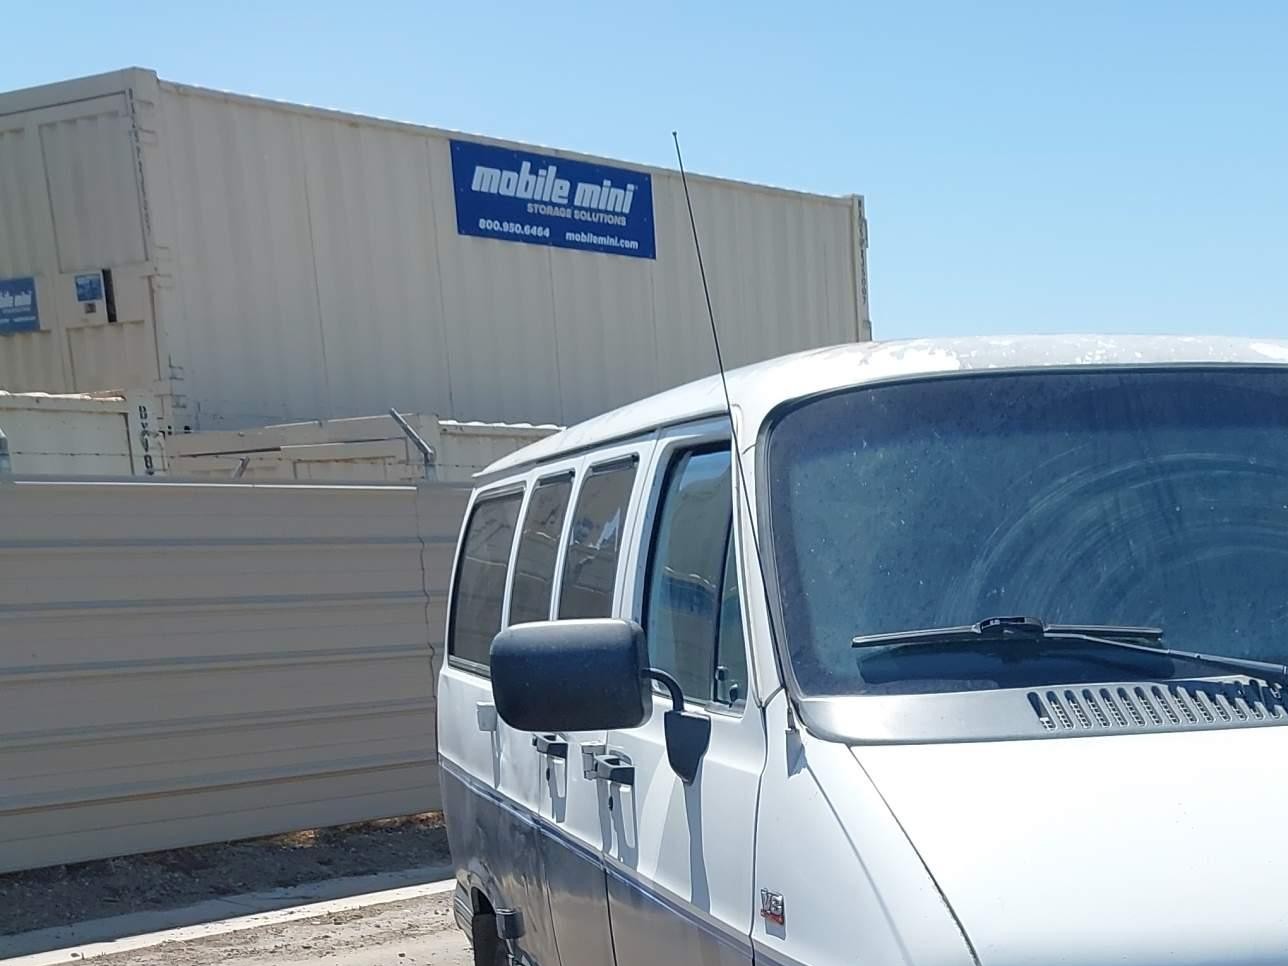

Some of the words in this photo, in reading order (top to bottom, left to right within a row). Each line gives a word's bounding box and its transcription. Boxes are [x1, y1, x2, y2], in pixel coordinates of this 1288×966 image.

[471, 160, 571, 205] mobile
[573, 179, 635, 214] mini
[527, 203, 572, 219] STORAGE
[573, 211, 627, 226] SOLUTIONS
[565, 231, 639, 250] mobilemini.com
